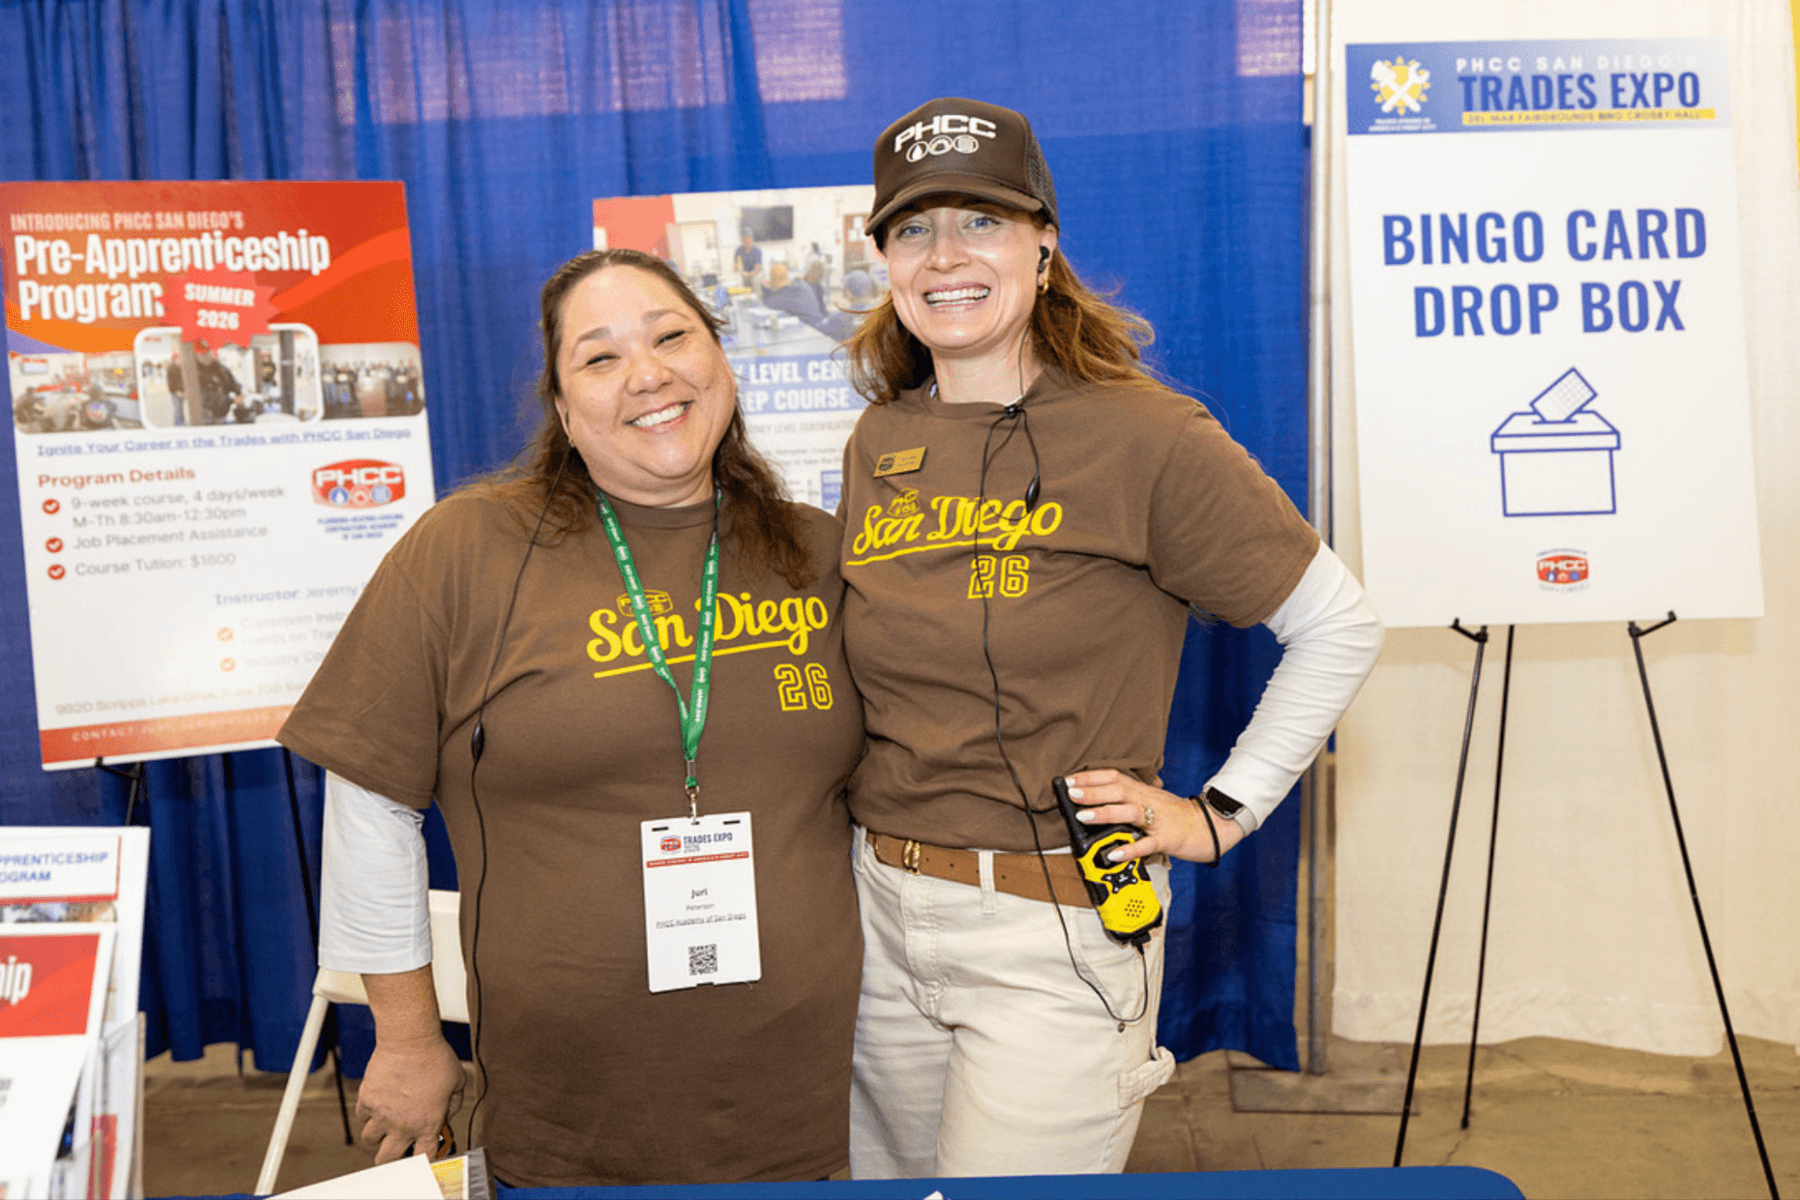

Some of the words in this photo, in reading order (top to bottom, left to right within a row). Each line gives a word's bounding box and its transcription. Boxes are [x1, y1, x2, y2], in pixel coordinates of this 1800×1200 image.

[1456, 57, 1522, 73] PHCC
[1536, 56, 1583, 72] SAN
[1457, 73, 1597, 112] TRADES
[1610, 71, 1701, 109] EXPO
[894, 114, 997, 153] PHCC
[10, 212, 111, 232] INTRODUCING
[113, 211, 153, 230] PHCC
[155, 211, 185, 230] SAN
[1382, 210, 1545, 266] BINGO
[1566, 207, 1707, 262] CARD
[14, 229, 331, 280] Pre-Apprenticeship
[18, 279, 166, 324] Program
[184, 282, 255, 308] SUMMER
[196, 308, 240, 330] 2026
[1414, 283, 1559, 338] DROP
[1580, 279, 1686, 334] BOX
[749, 361, 803, 385] LEVEL
[744, 390, 770, 412] EP
[774, 387, 850, 411] COURSE
[124, 439, 171, 452] Career
[176, 437, 189, 449] in
[192, 436, 216, 449] the
[219, 434, 266, 447] Trades
[270, 432, 299, 445] with
[302, 431, 342, 443] PHCC
[345, 429, 371, 441] San
[373, 428, 411, 441] Diego
[38, 473, 124, 489] Program
[129, 467, 195, 483] Details
[315, 467, 401, 487] PHCC
[71, 494, 128, 510] 9-week
[132, 491, 189, 508] course,
[193, 490, 203, 503] 4
[206, 485, 285, 503] days/week
[73, 514, 116, 529] M-Th
[852, 504, 926, 556] San
[926, 495, 1063, 551] Diego
[73, 535, 101, 549] Job
[105, 530, 185, 547] Placement
[189, 525, 269, 542] Assistance
[74, 561, 130, 577] Course
[190, 552, 237, 568] $1600
[967, 554, 1031, 600] 26
[306, 584, 358, 600] Jeremy
[586, 608, 694, 663] San
[694, 592, 829, 656] Diego
[772, 662, 834, 712] 26
[71, 725, 134, 742] CONTACT
[683, 833, 712, 845] TRADES
[713, 831, 733, 843] EXPO
[690, 888, 708, 900] Juri
